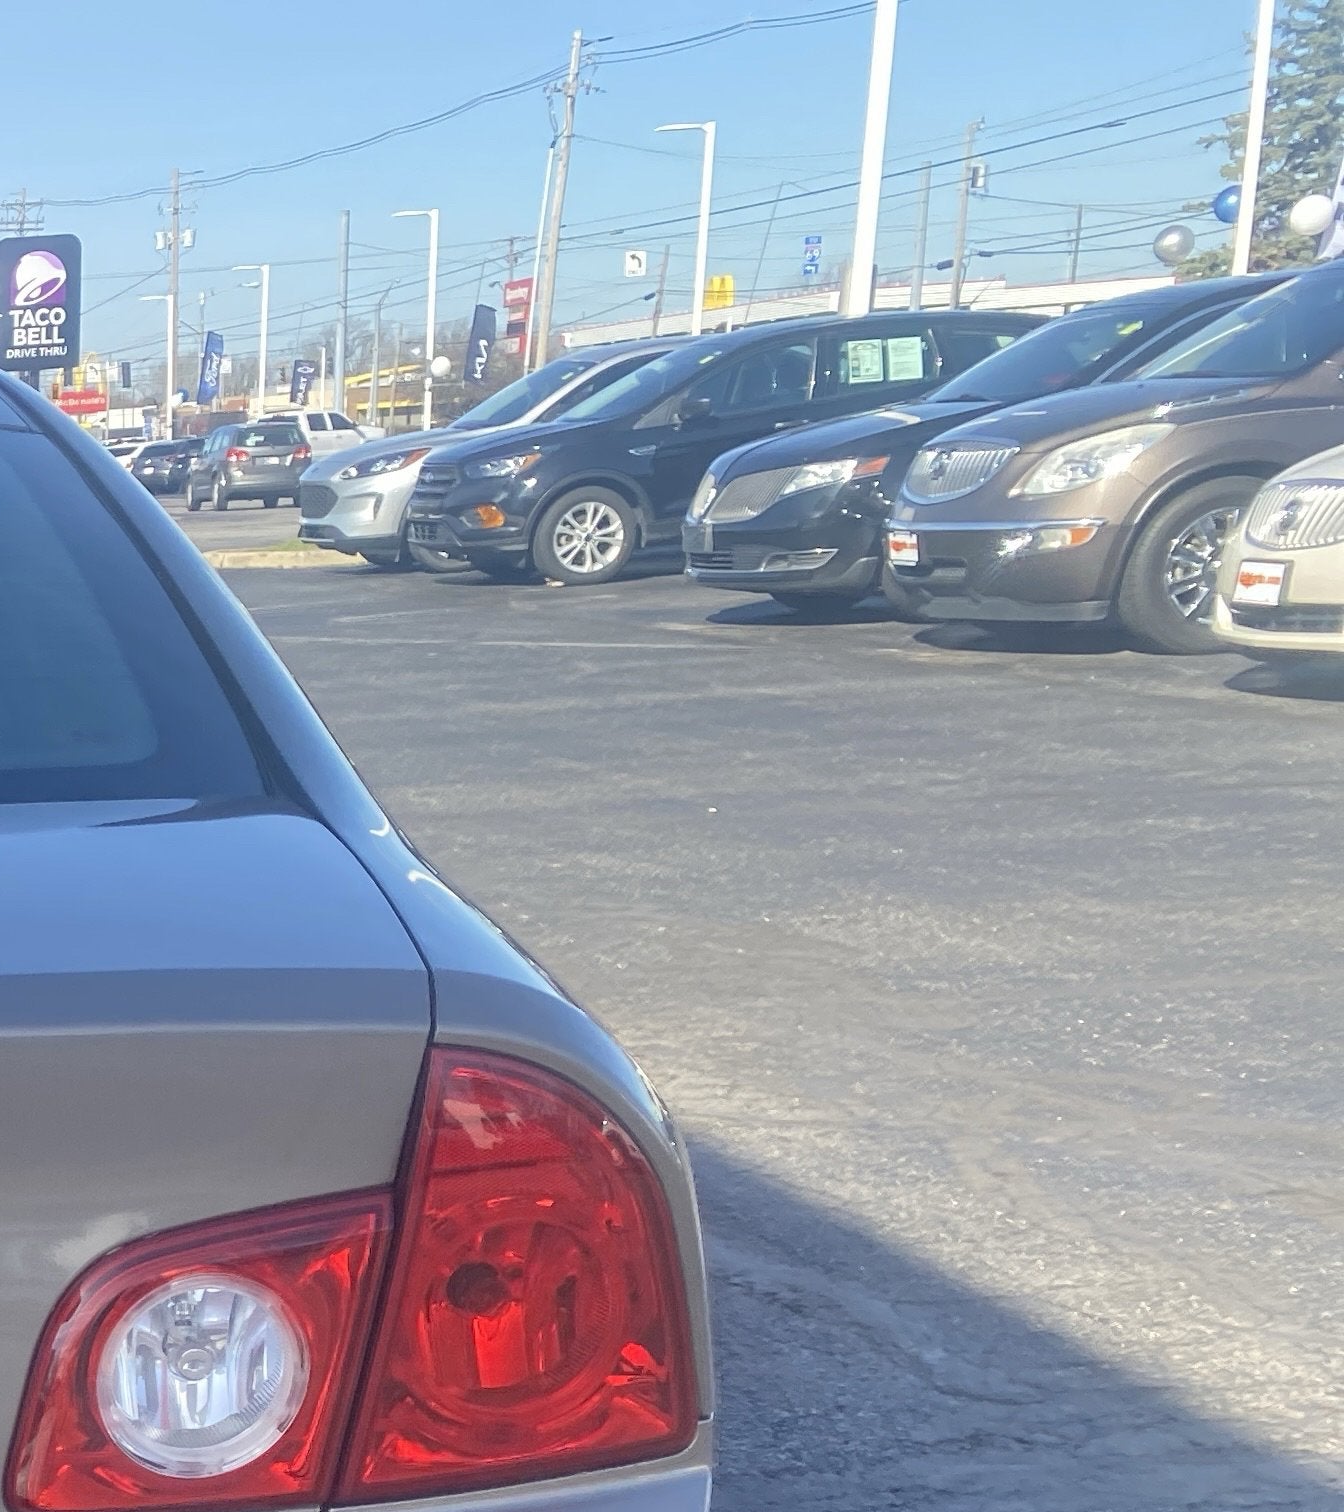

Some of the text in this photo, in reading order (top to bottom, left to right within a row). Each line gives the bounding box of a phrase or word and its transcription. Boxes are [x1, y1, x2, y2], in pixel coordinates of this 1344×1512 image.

[806, 249, 820, 259] 69
[9, 307, 67, 327] TACO
[13, 326, 65, 346] BELL
[6, 346, 68, 359] DRIVE THRU
[204, 351, 221, 387] Ford
